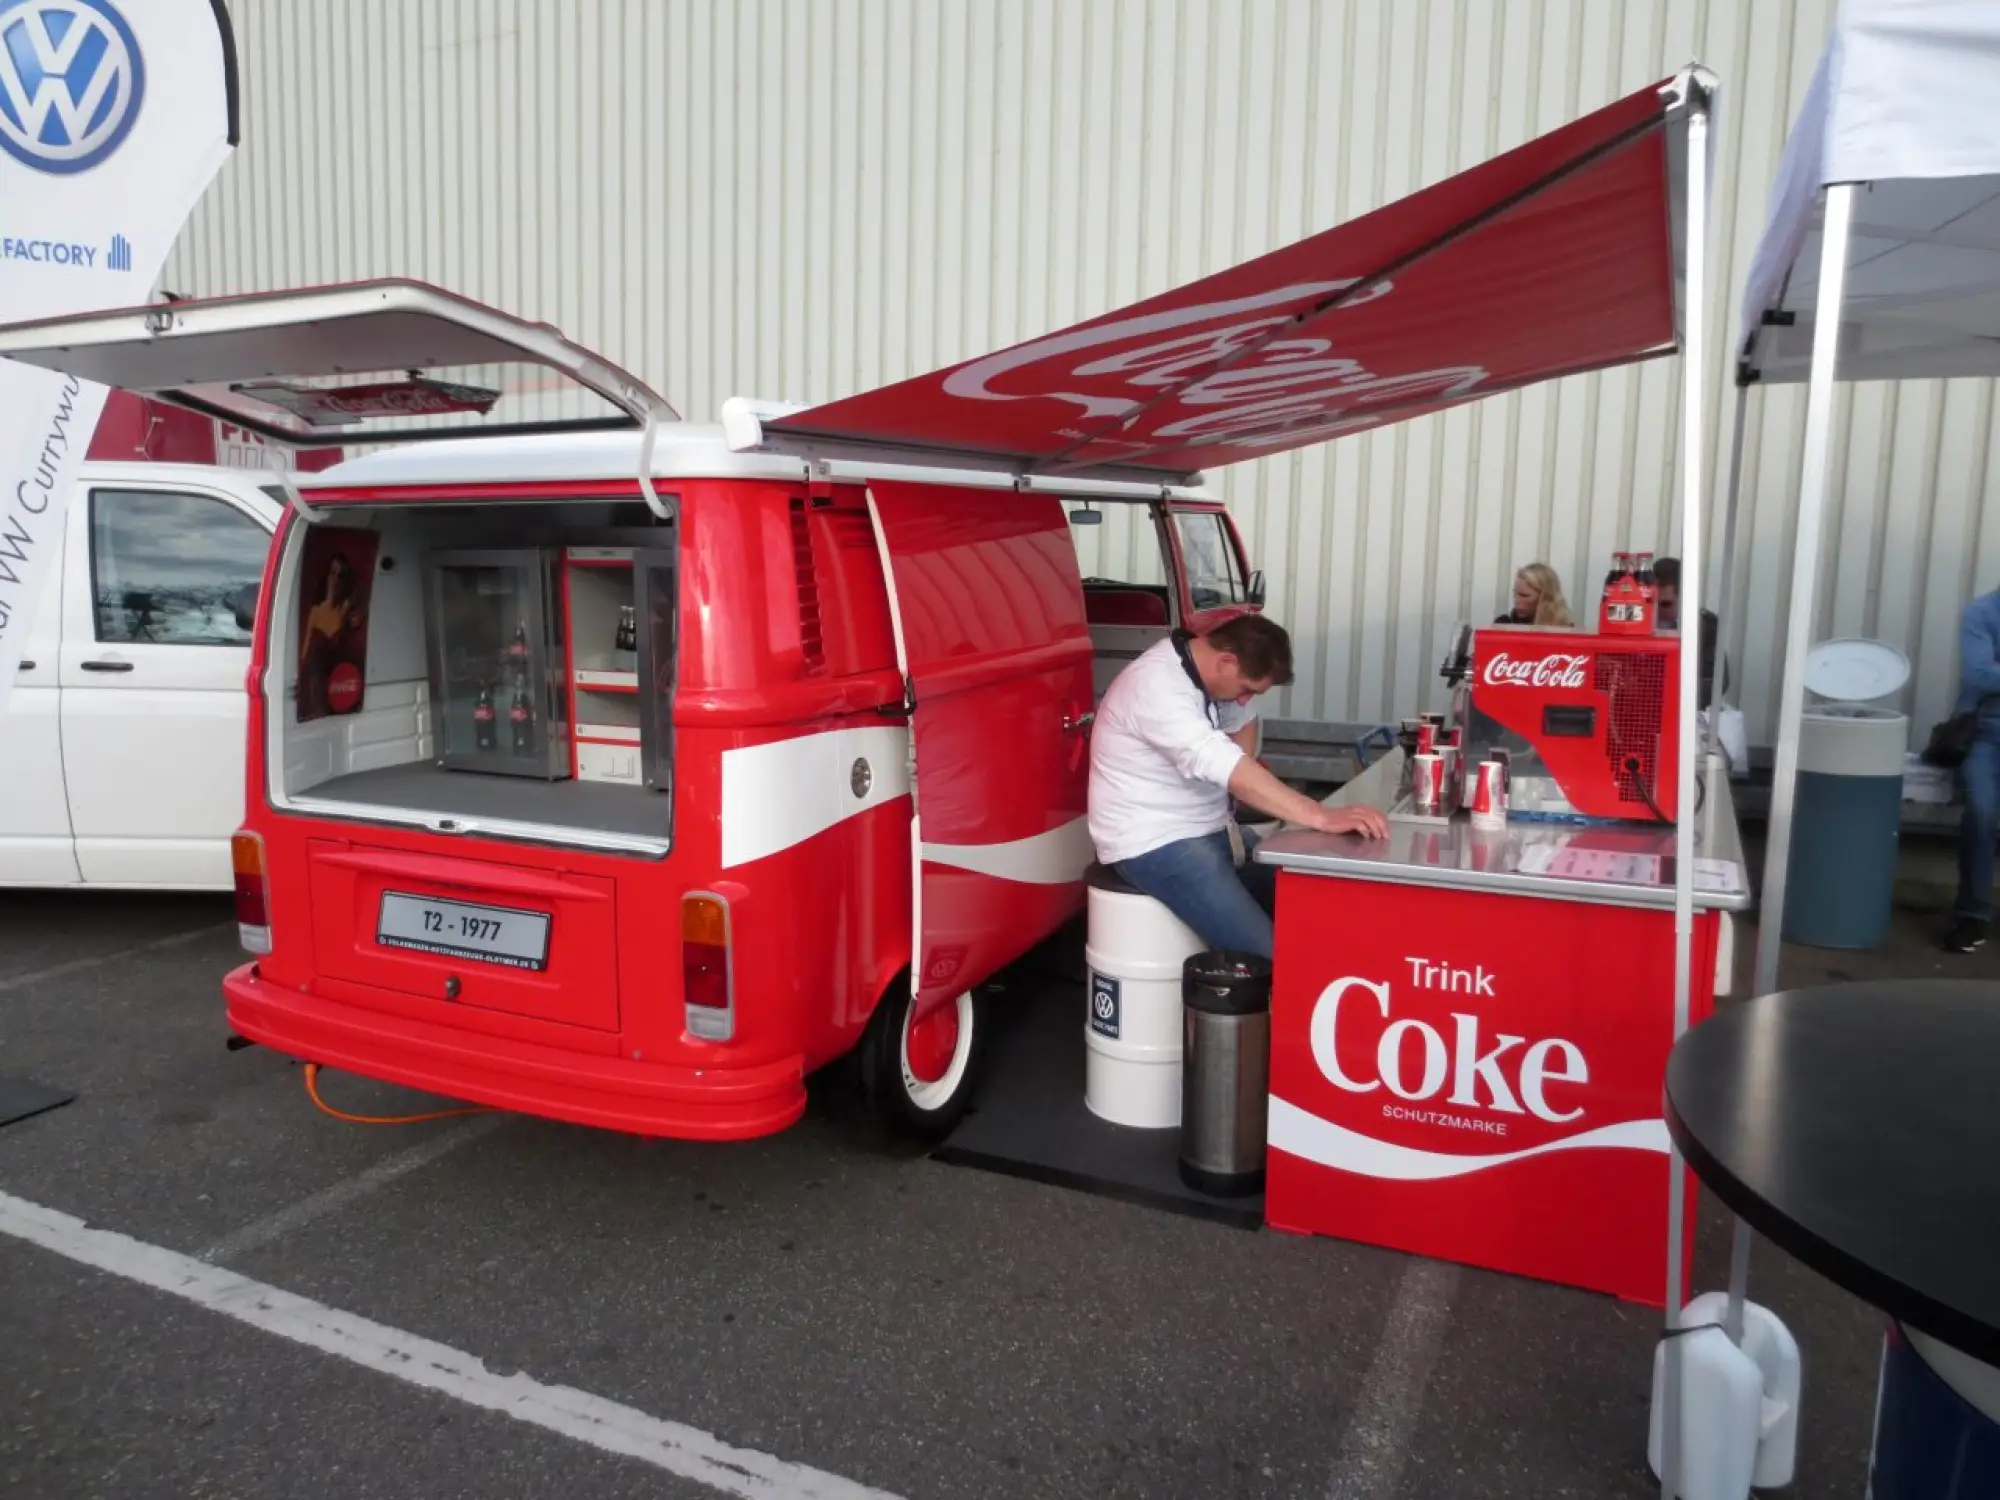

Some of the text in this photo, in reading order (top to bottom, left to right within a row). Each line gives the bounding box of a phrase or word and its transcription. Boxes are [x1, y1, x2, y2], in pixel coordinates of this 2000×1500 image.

[0, 238, 97, 268] FACTORY
[1483, 652, 1590, 688] Coca-Cola
[423, 910, 443, 932] T2
[460, 916, 503, 941] 1977
[1404, 956, 1496, 997] Trink
[1309, 975, 1590, 1123] Coke
[1382, 1103, 1508, 1136] SCHUTZMARKE
